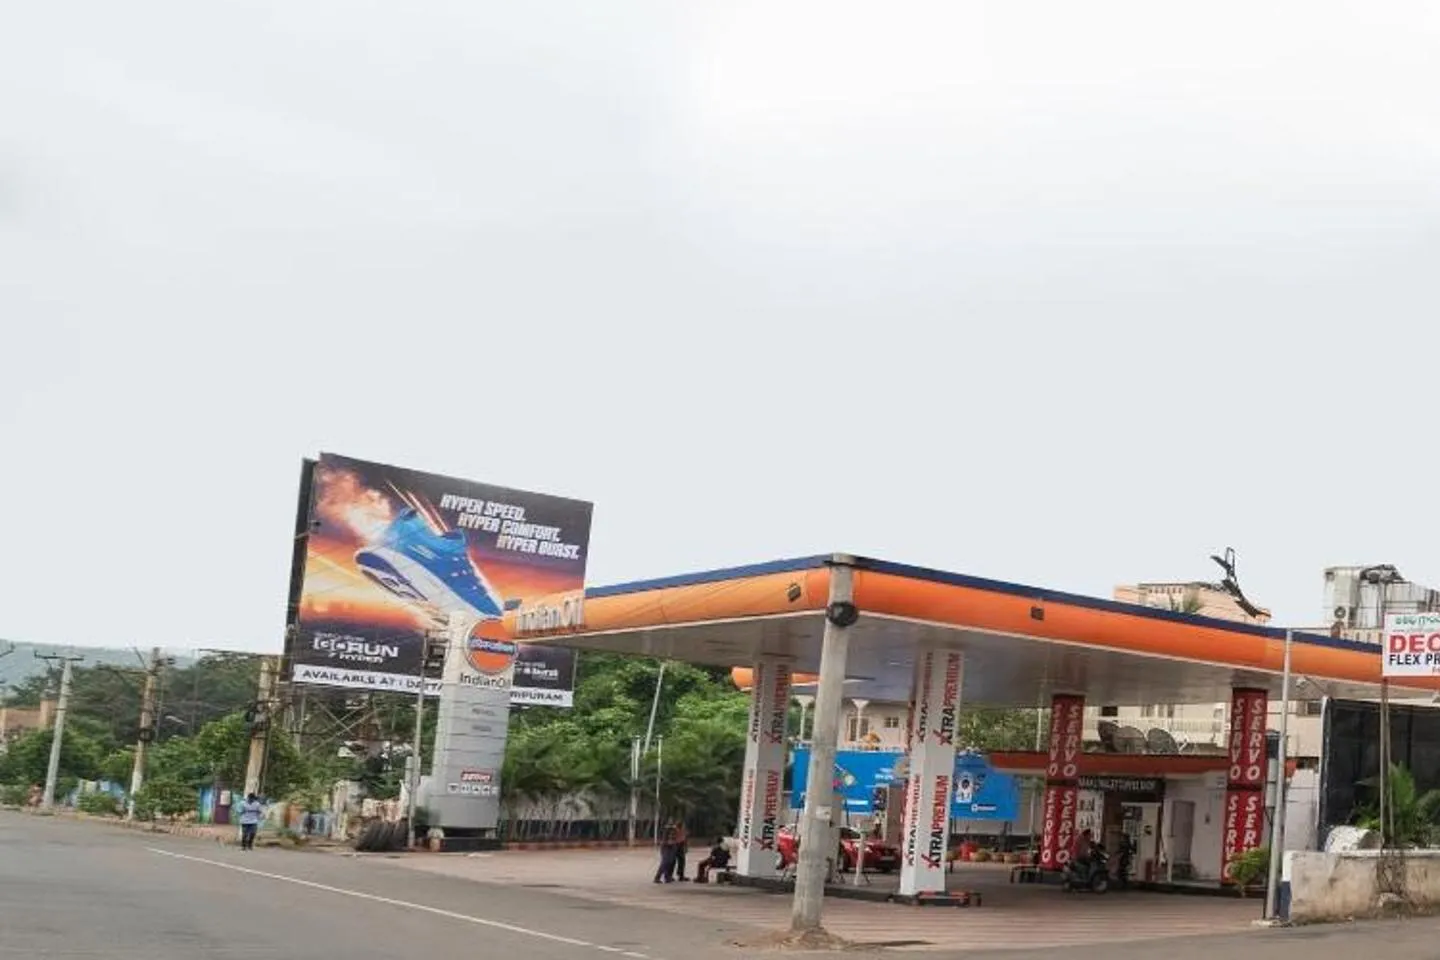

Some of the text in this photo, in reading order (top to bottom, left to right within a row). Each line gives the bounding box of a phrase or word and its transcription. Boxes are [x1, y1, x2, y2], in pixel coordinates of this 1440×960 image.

[440, 494, 484, 515] HYPER
[457, 512, 500, 533] HYPER
[495, 535, 539, 553] HYPER
[302, 669, 376, 684] AVAILABLE
[1389, 654, 1421, 666] FLEX
[932, 652, 961, 746] XTRAPREMIUM
[1063, 704, 1082, 777] SERVO
[1229, 698, 1245, 781] SERVO
[1246, 698, 1264, 781] SERVO
[921, 775, 949, 869] XTRAPREMIUM
[1055, 790, 1075, 864] SERVO
